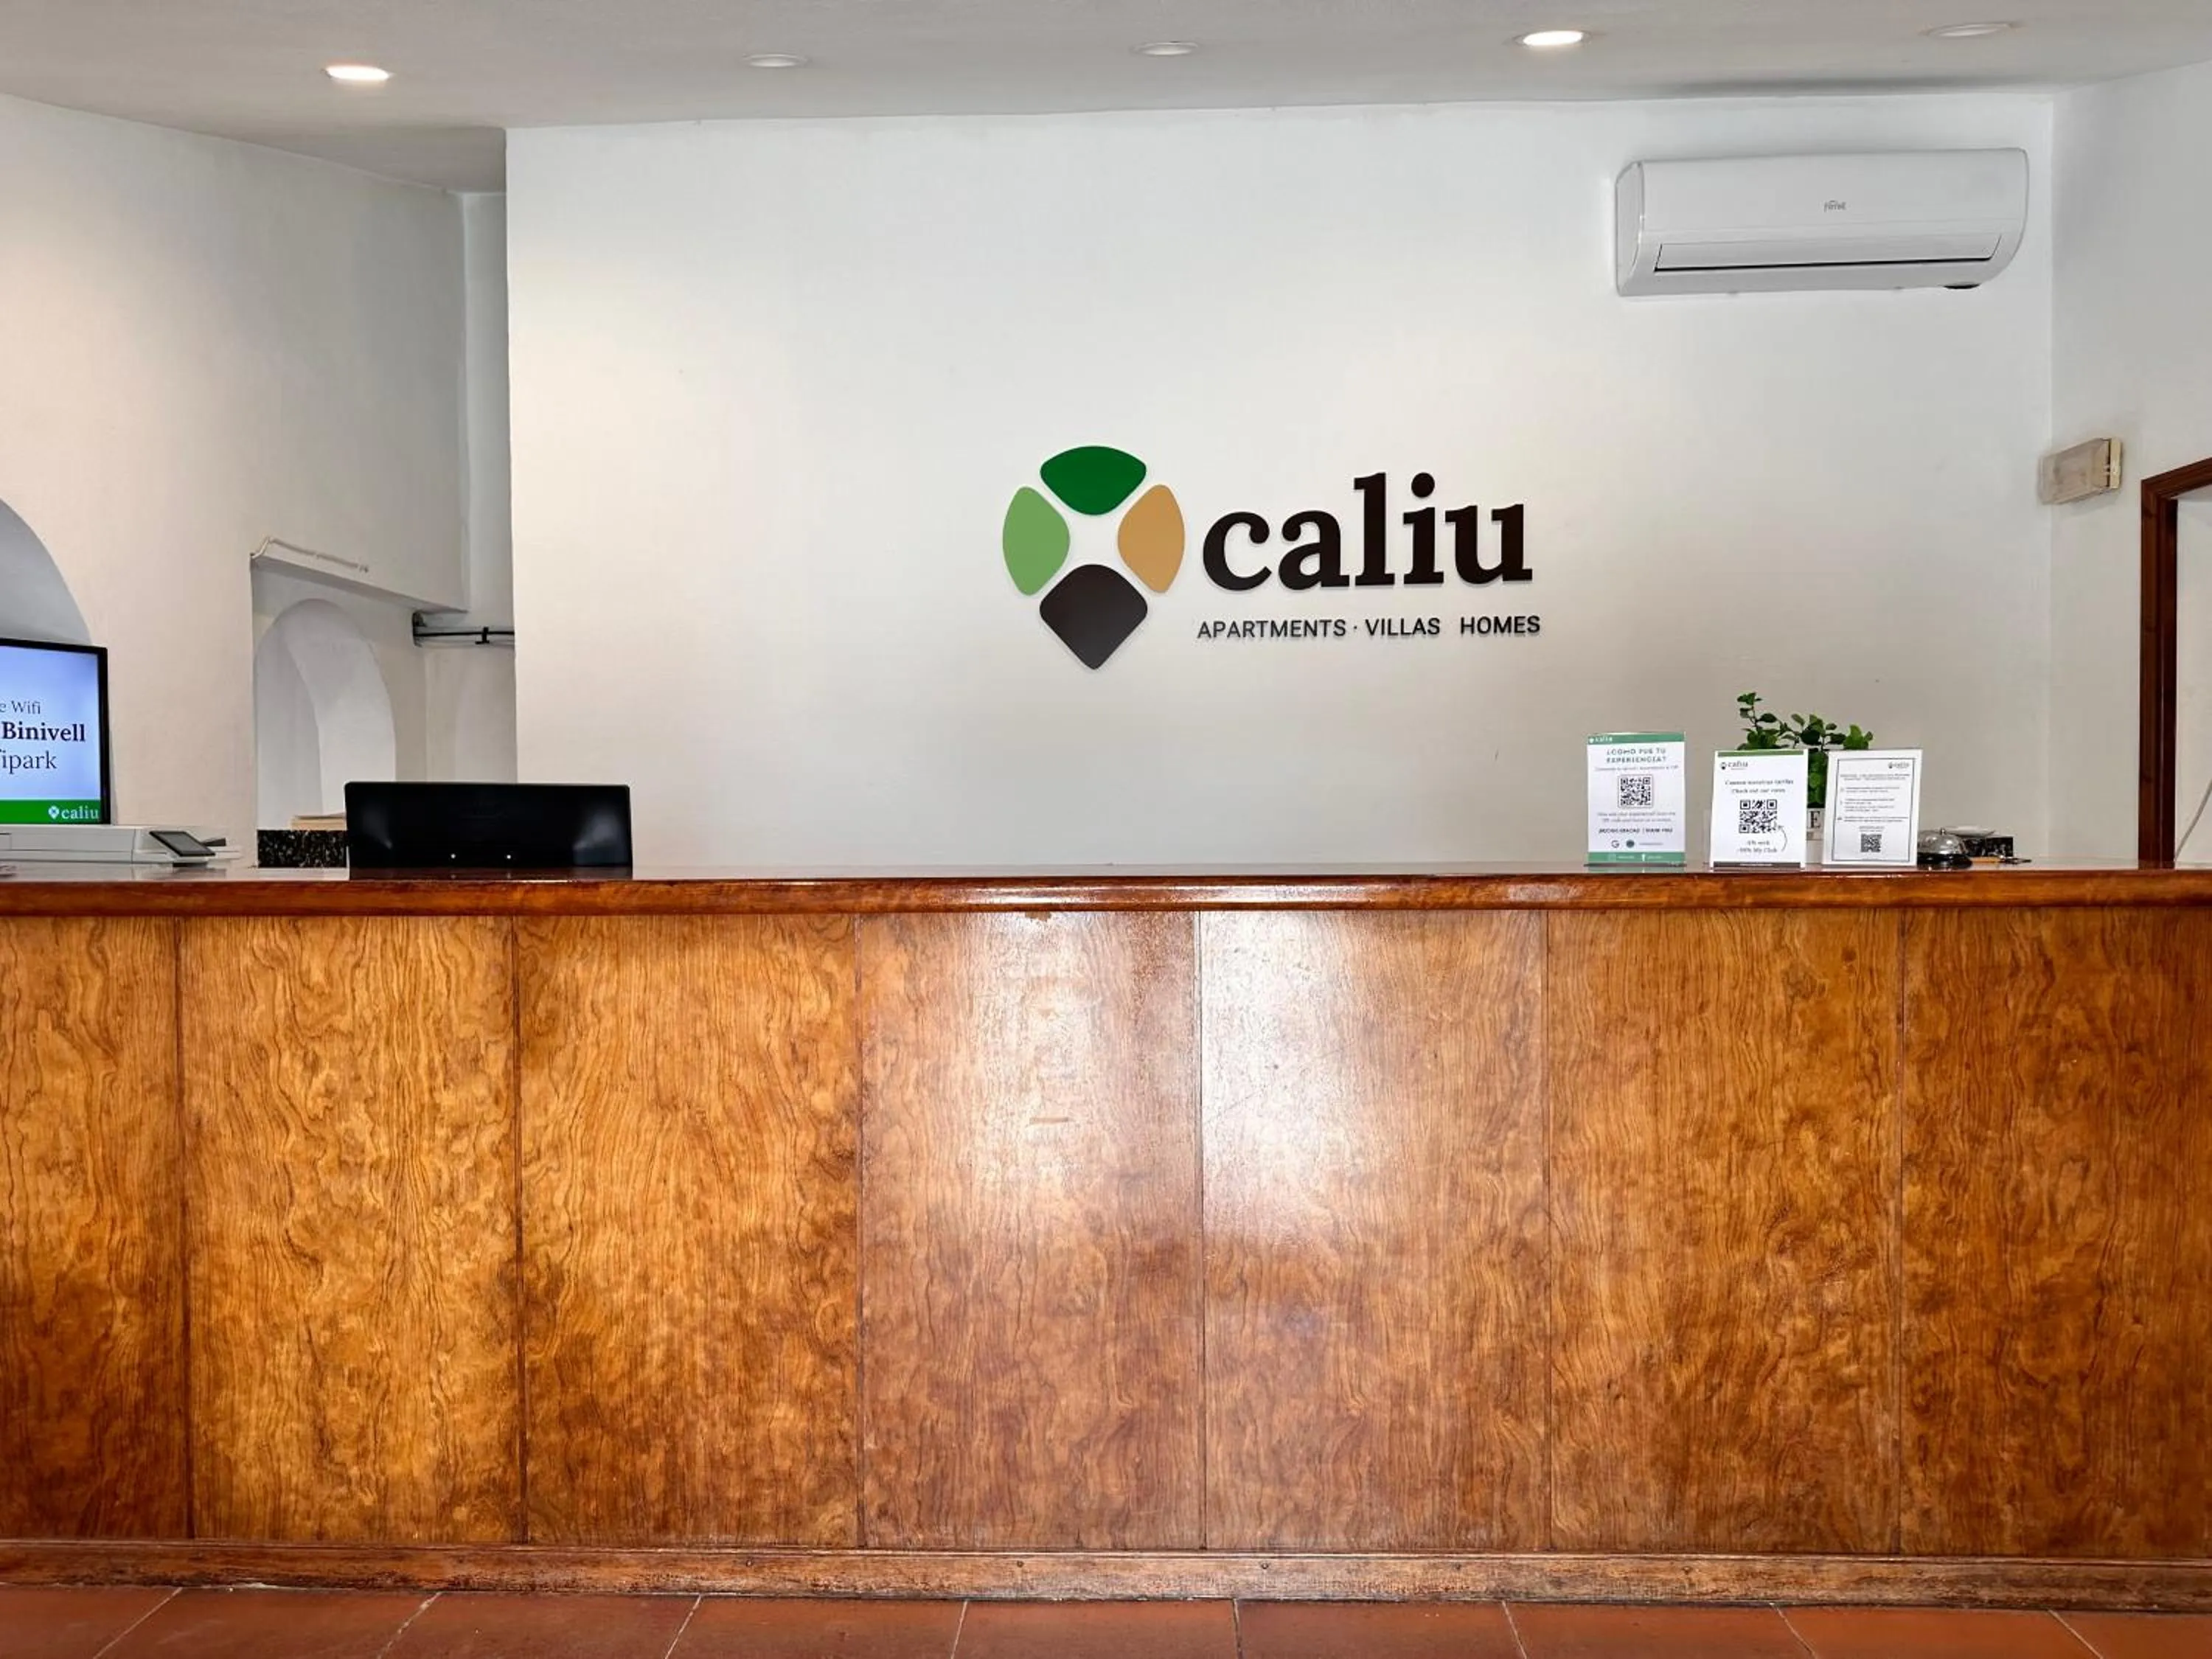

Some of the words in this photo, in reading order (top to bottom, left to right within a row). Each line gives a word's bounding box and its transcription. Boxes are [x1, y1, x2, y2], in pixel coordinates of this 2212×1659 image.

[1203, 472, 1533, 591] caliu
[1197, 619, 1346, 639] APARTMENTS
[1365, 617, 1441, 636] VILLAS
[1460, 615, 1541, 635] HOMES
[11, 700, 41, 714] Wifi
[1, 720, 86, 742] Binivell
[0, 748, 58, 774] ipark
[61, 806, 100, 819] caliu
